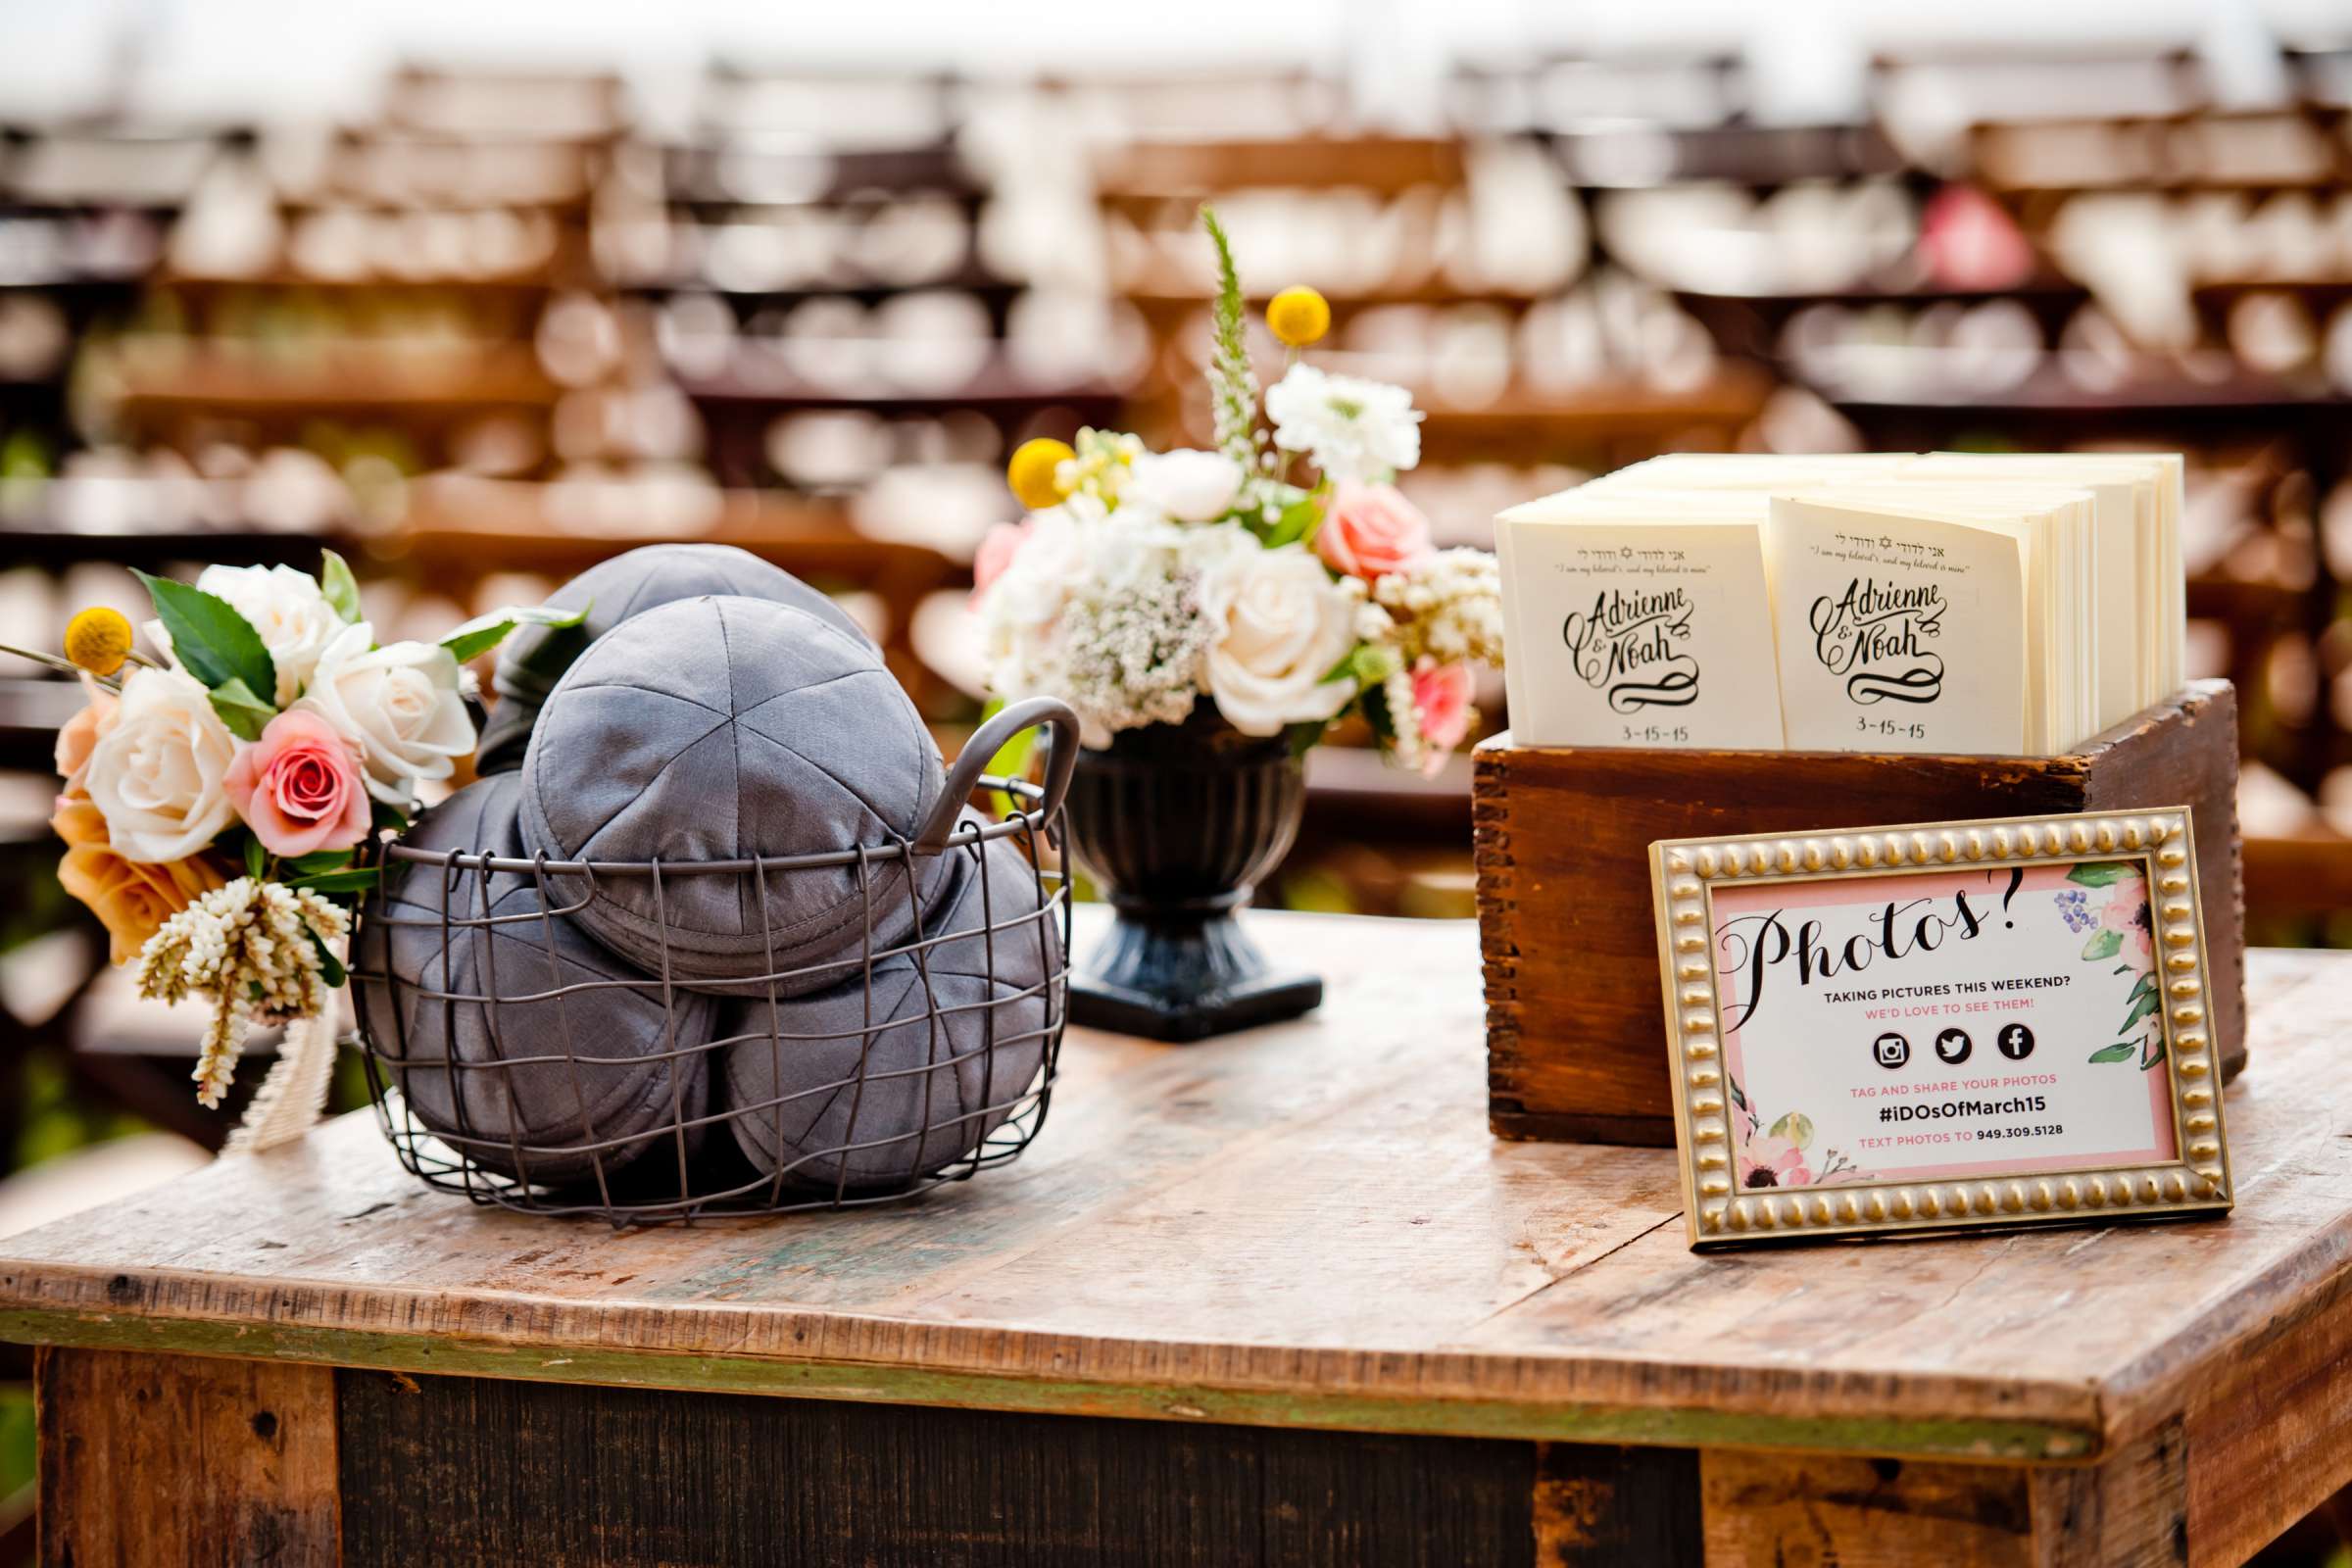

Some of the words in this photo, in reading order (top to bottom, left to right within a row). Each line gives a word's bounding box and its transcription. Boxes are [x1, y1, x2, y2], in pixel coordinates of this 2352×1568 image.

[1835, 551, 1847, 563] my
[1899, 560, 1912, 570] my
[1913, 559, 1938, 571] beloved
[1564, 587, 1693, 642] Adrienne
[1811, 577, 1946, 634] Adrienne
[1838, 625, 1852, 640] &
[1587, 624, 1681, 686] Noah
[1592, 638, 1606, 654] &
[1829, 618, 1921, 675] Noah
[1623, 725, 1689, 742] 3-15-15
[1856, 715, 1926, 739] 3-15-15
[1824, 990, 1878, 1004] TAKING
[1882, 984, 1951, 1000] PICTURES
[1955, 982, 1986, 995] THIS
[1991, 975, 2071, 991] WEEKEND?
[1865, 1007, 1900, 1020] WE'D
[1905, 1004, 1938, 1017] LOVE
[1942, 1003, 1961, 1015] TO
[1965, 1002, 1989, 1013] SEE
[1993, 998, 2034, 1010] THEM!
[1850, 1087, 1876, 1099] TAG
[1881, 1084, 1909, 1097] AND
[1913, 1081, 1958, 1095] SHARE
[1962, 1078, 1998, 1090] YOUR
[2003, 1074, 2058, 1087] PHOTOS
[1879, 1096, 2046, 1123] #iDOsOfMarch15
[1859, 1136, 1892, 1149] TEXT
[1897, 1132, 1950, 1146] PHOTOS
[1955, 1131, 1973, 1142] TO
[1977, 1125, 2064, 1141] 949.309.5128
